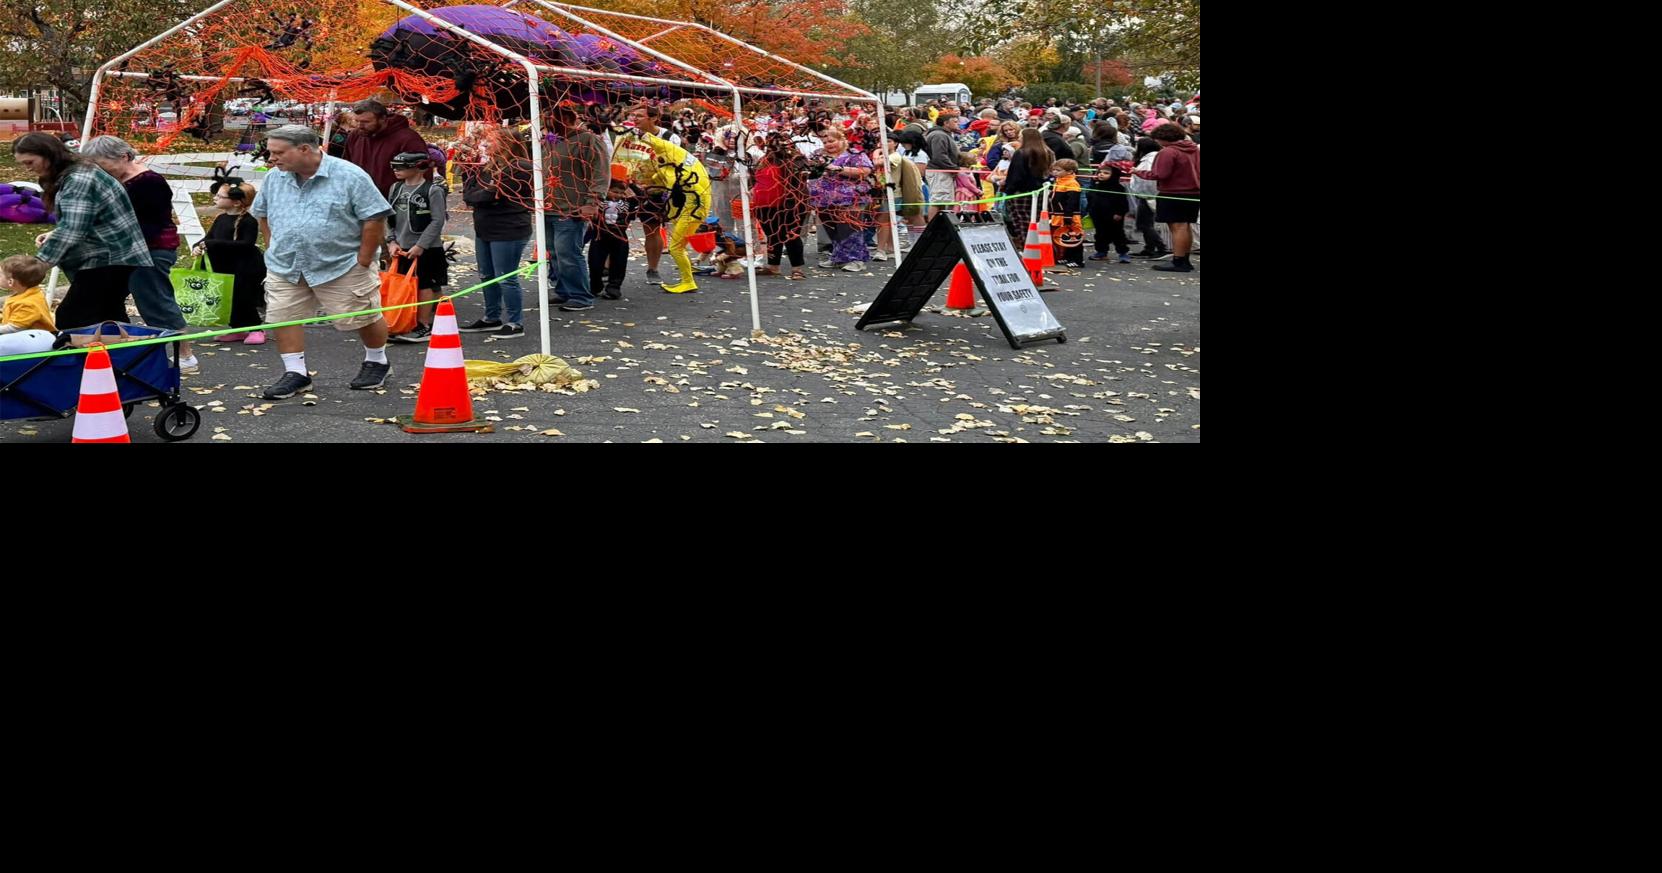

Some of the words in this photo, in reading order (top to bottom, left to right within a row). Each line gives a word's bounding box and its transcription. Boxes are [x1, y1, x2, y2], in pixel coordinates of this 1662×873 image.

[971, 243, 993, 254] PLEASE
[992, 242, 1007, 252] STAY
[995, 257, 1008, 267] THE
[991, 274, 1010, 285] TRAIL
[1007, 273, 1021, 283] FOR
[997, 291, 1014, 302] YOUR
[1012, 289, 1033, 300] SAFETY
